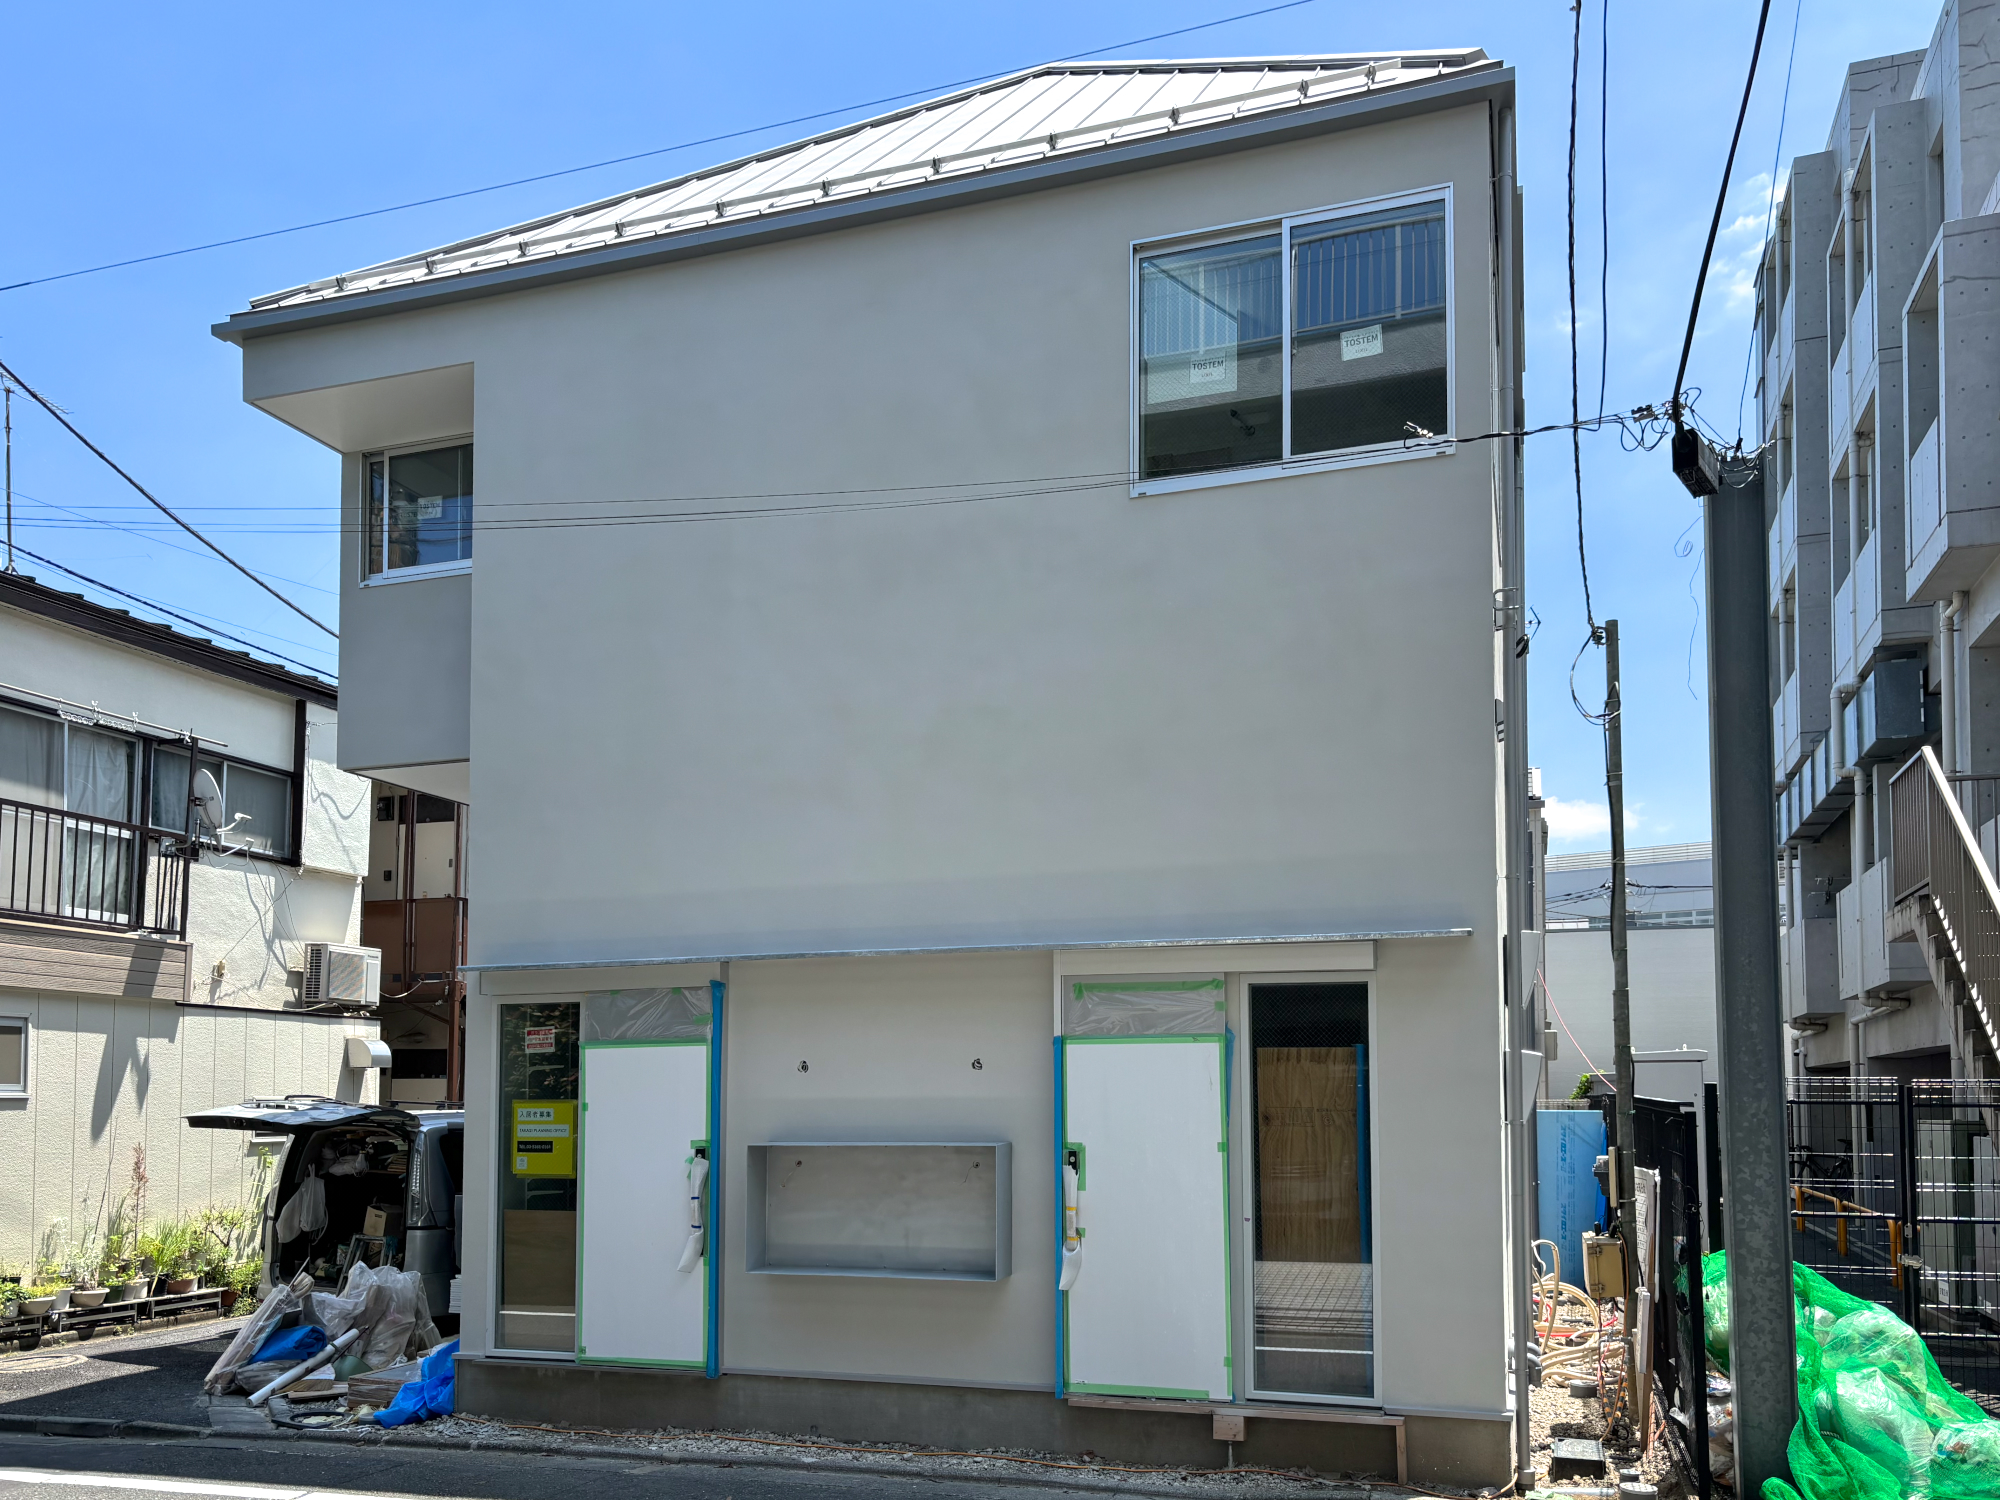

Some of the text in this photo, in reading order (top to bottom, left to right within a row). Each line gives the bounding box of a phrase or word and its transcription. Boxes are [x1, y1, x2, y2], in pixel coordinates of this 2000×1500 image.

[1343, 333, 1379, 348] TOSTEM
[1191, 359, 1224, 371] TOSTEM
[519, 1110, 552, 1118] 入居者募集
